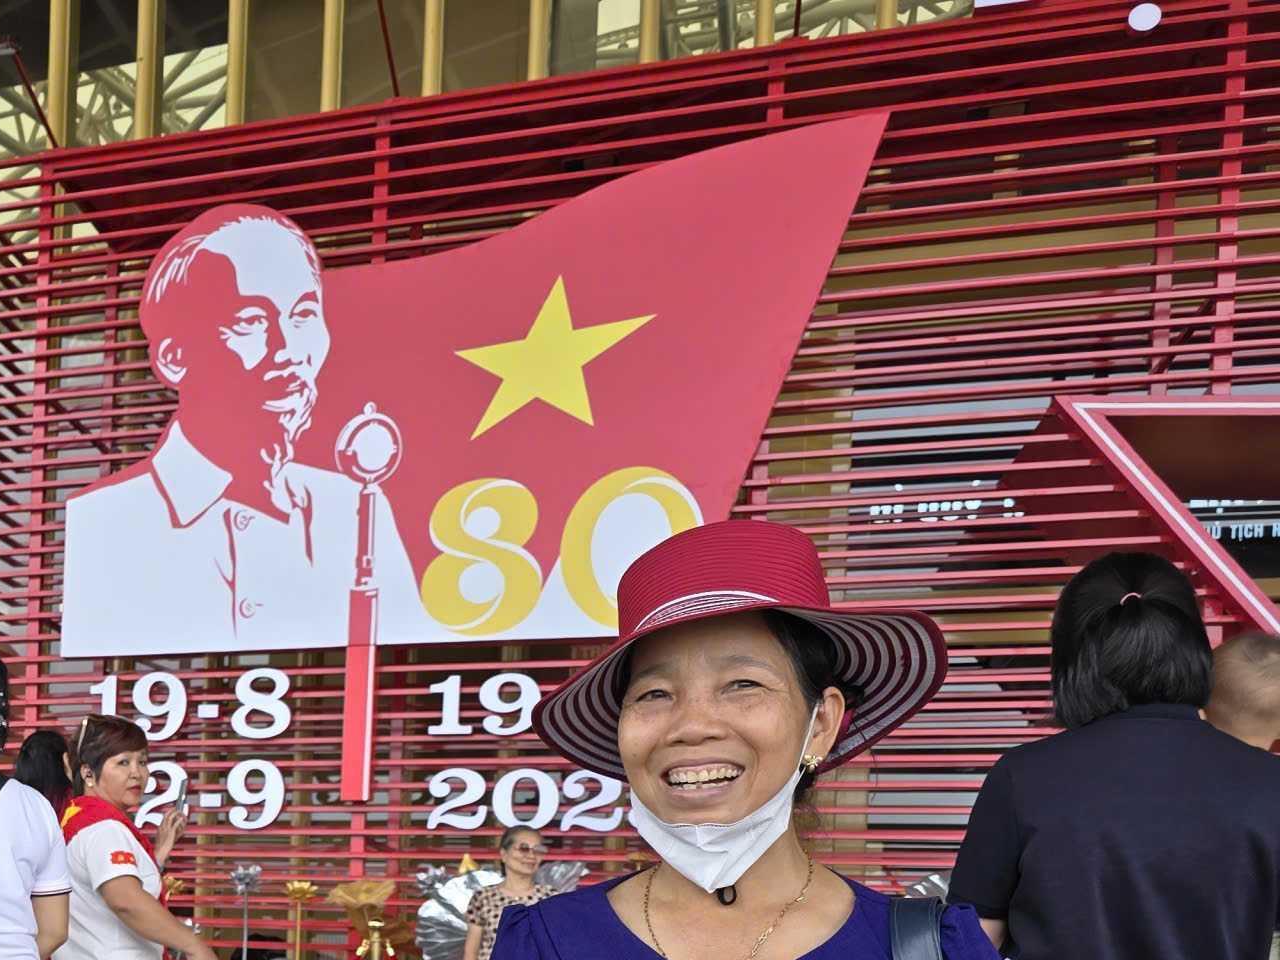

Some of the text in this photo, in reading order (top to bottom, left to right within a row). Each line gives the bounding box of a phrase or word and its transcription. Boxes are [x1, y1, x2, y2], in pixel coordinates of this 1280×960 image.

[419, 466, 705, 637] 80
[89, 667, 292, 741] 19-8
[427, 672, 542, 736] 19
[134, 758, 285, 830] 2-9
[426, 767, 637, 832] 202
